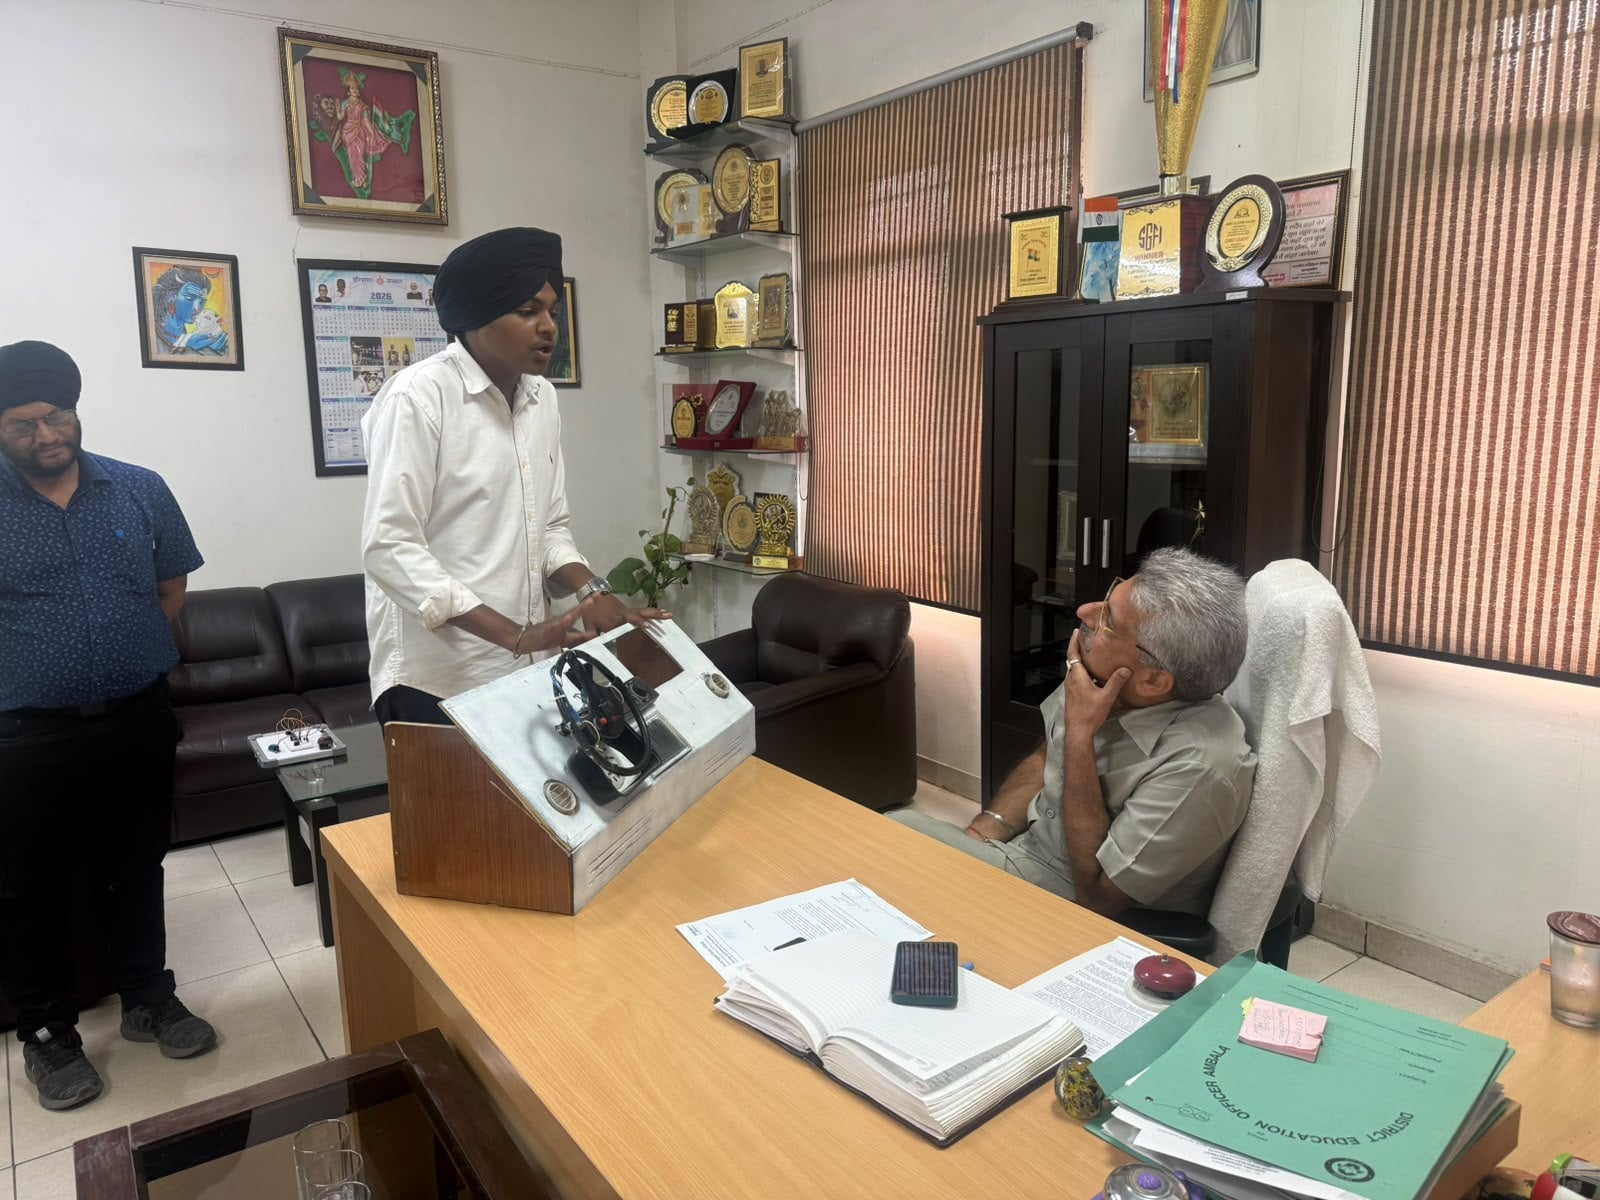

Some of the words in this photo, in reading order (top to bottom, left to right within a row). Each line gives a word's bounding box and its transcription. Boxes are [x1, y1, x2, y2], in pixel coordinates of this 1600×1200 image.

[1138, 222, 1163, 251] SGFI
[1134, 250, 1164, 261] WINNER
[370, 292, 392, 300] 2026
[1202, 1044, 1230, 1078] AMBALA
[1204, 1080, 1251, 1120] OFFICER
[1254, 1119, 1359, 1147] EDUCATION
[1365, 1111, 1415, 1144] DISTRICT
